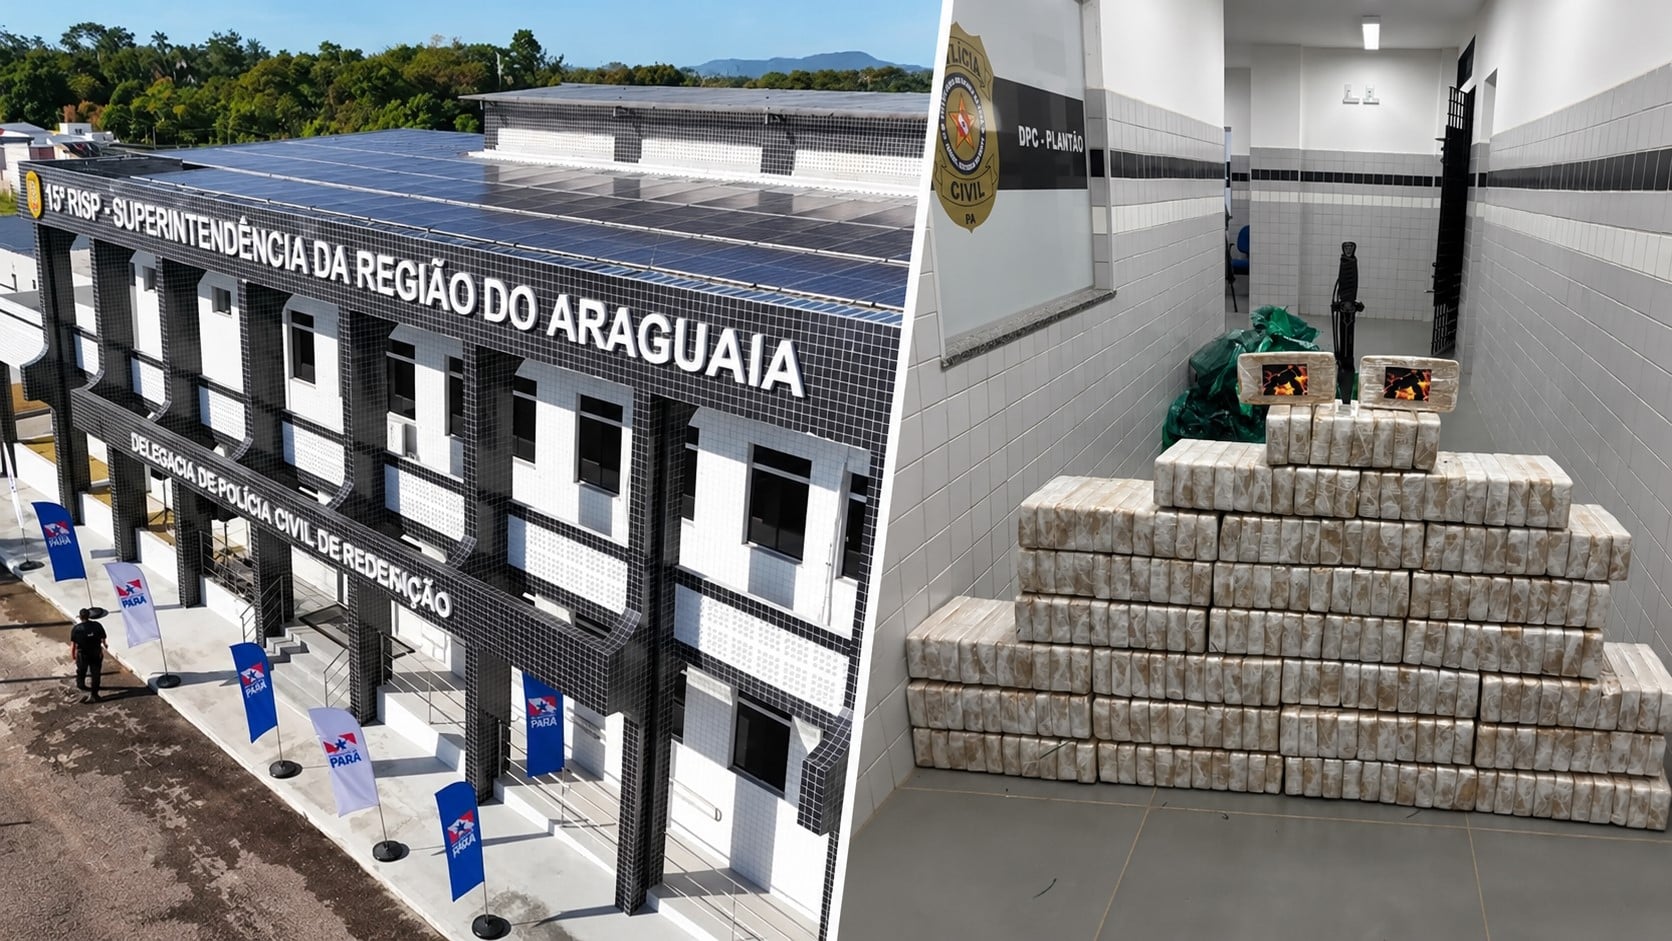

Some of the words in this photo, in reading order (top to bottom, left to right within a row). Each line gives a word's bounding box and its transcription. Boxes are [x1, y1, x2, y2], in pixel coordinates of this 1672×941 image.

[1018, 125, 1039, 148] DPC
[1046, 130, 1084, 153] PLANTÃO
[951, 181, 985, 202] CIVIL
[965, 213, 976, 225] PA
[67, 187, 101, 221] RISP
[112, 195, 311, 274] SUPERINTENDÊNCIA
[313, 240, 351, 285] DA
[356, 250, 478, 315] REGIÃO
[484, 277, 540, 331] DO
[546, 294, 806, 398] ARAGUAIA
[131, 432, 197, 483] DELEGACIA
[198, 466, 217, 494] DE
[218, 477, 272, 525] POLÍCIA
[274, 507, 315, 547] CIVIL
[317, 528, 340, 561] DE
[342, 542, 453, 618] REDENÇÃO
